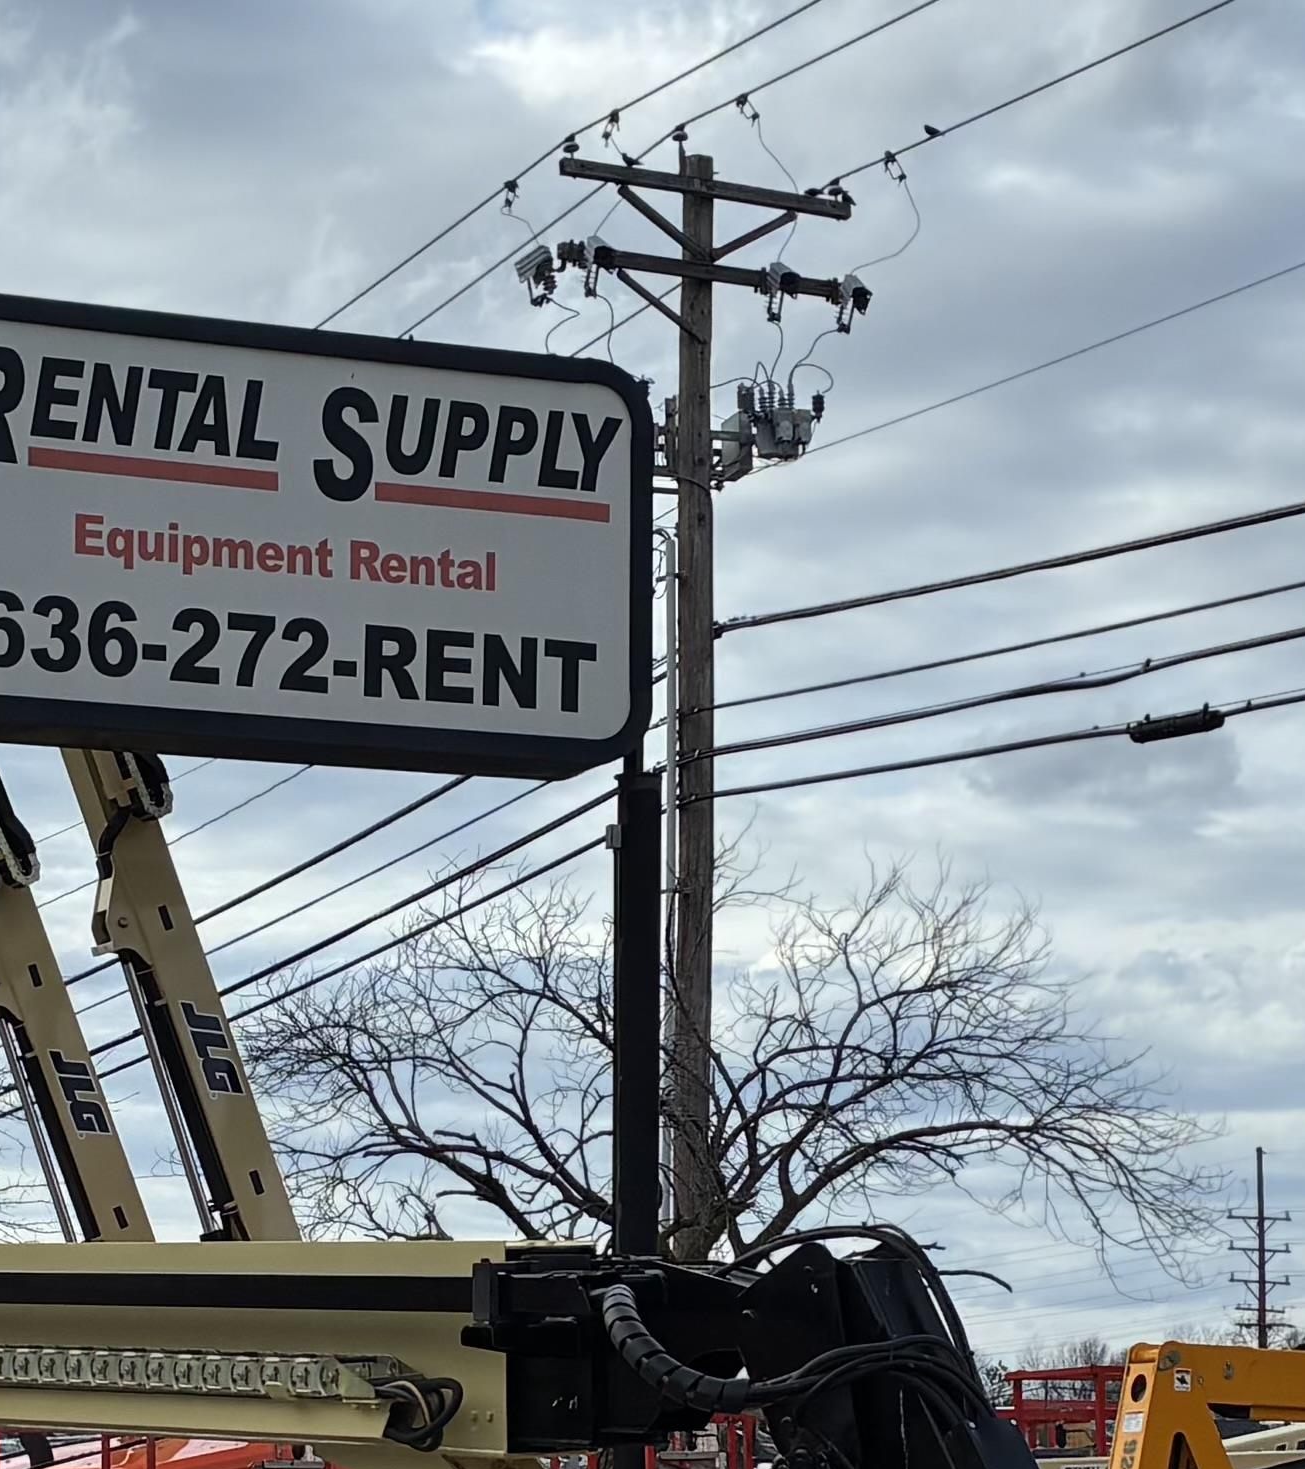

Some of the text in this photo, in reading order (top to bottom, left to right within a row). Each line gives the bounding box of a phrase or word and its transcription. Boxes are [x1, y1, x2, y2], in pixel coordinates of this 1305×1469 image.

[314, 387, 623, 501] SUPPLY
[75, 513, 495, 591] Equipment Rental
[47, 1049, 112, 1135] JLG
[179, 1001, 245, 1095] JLG
